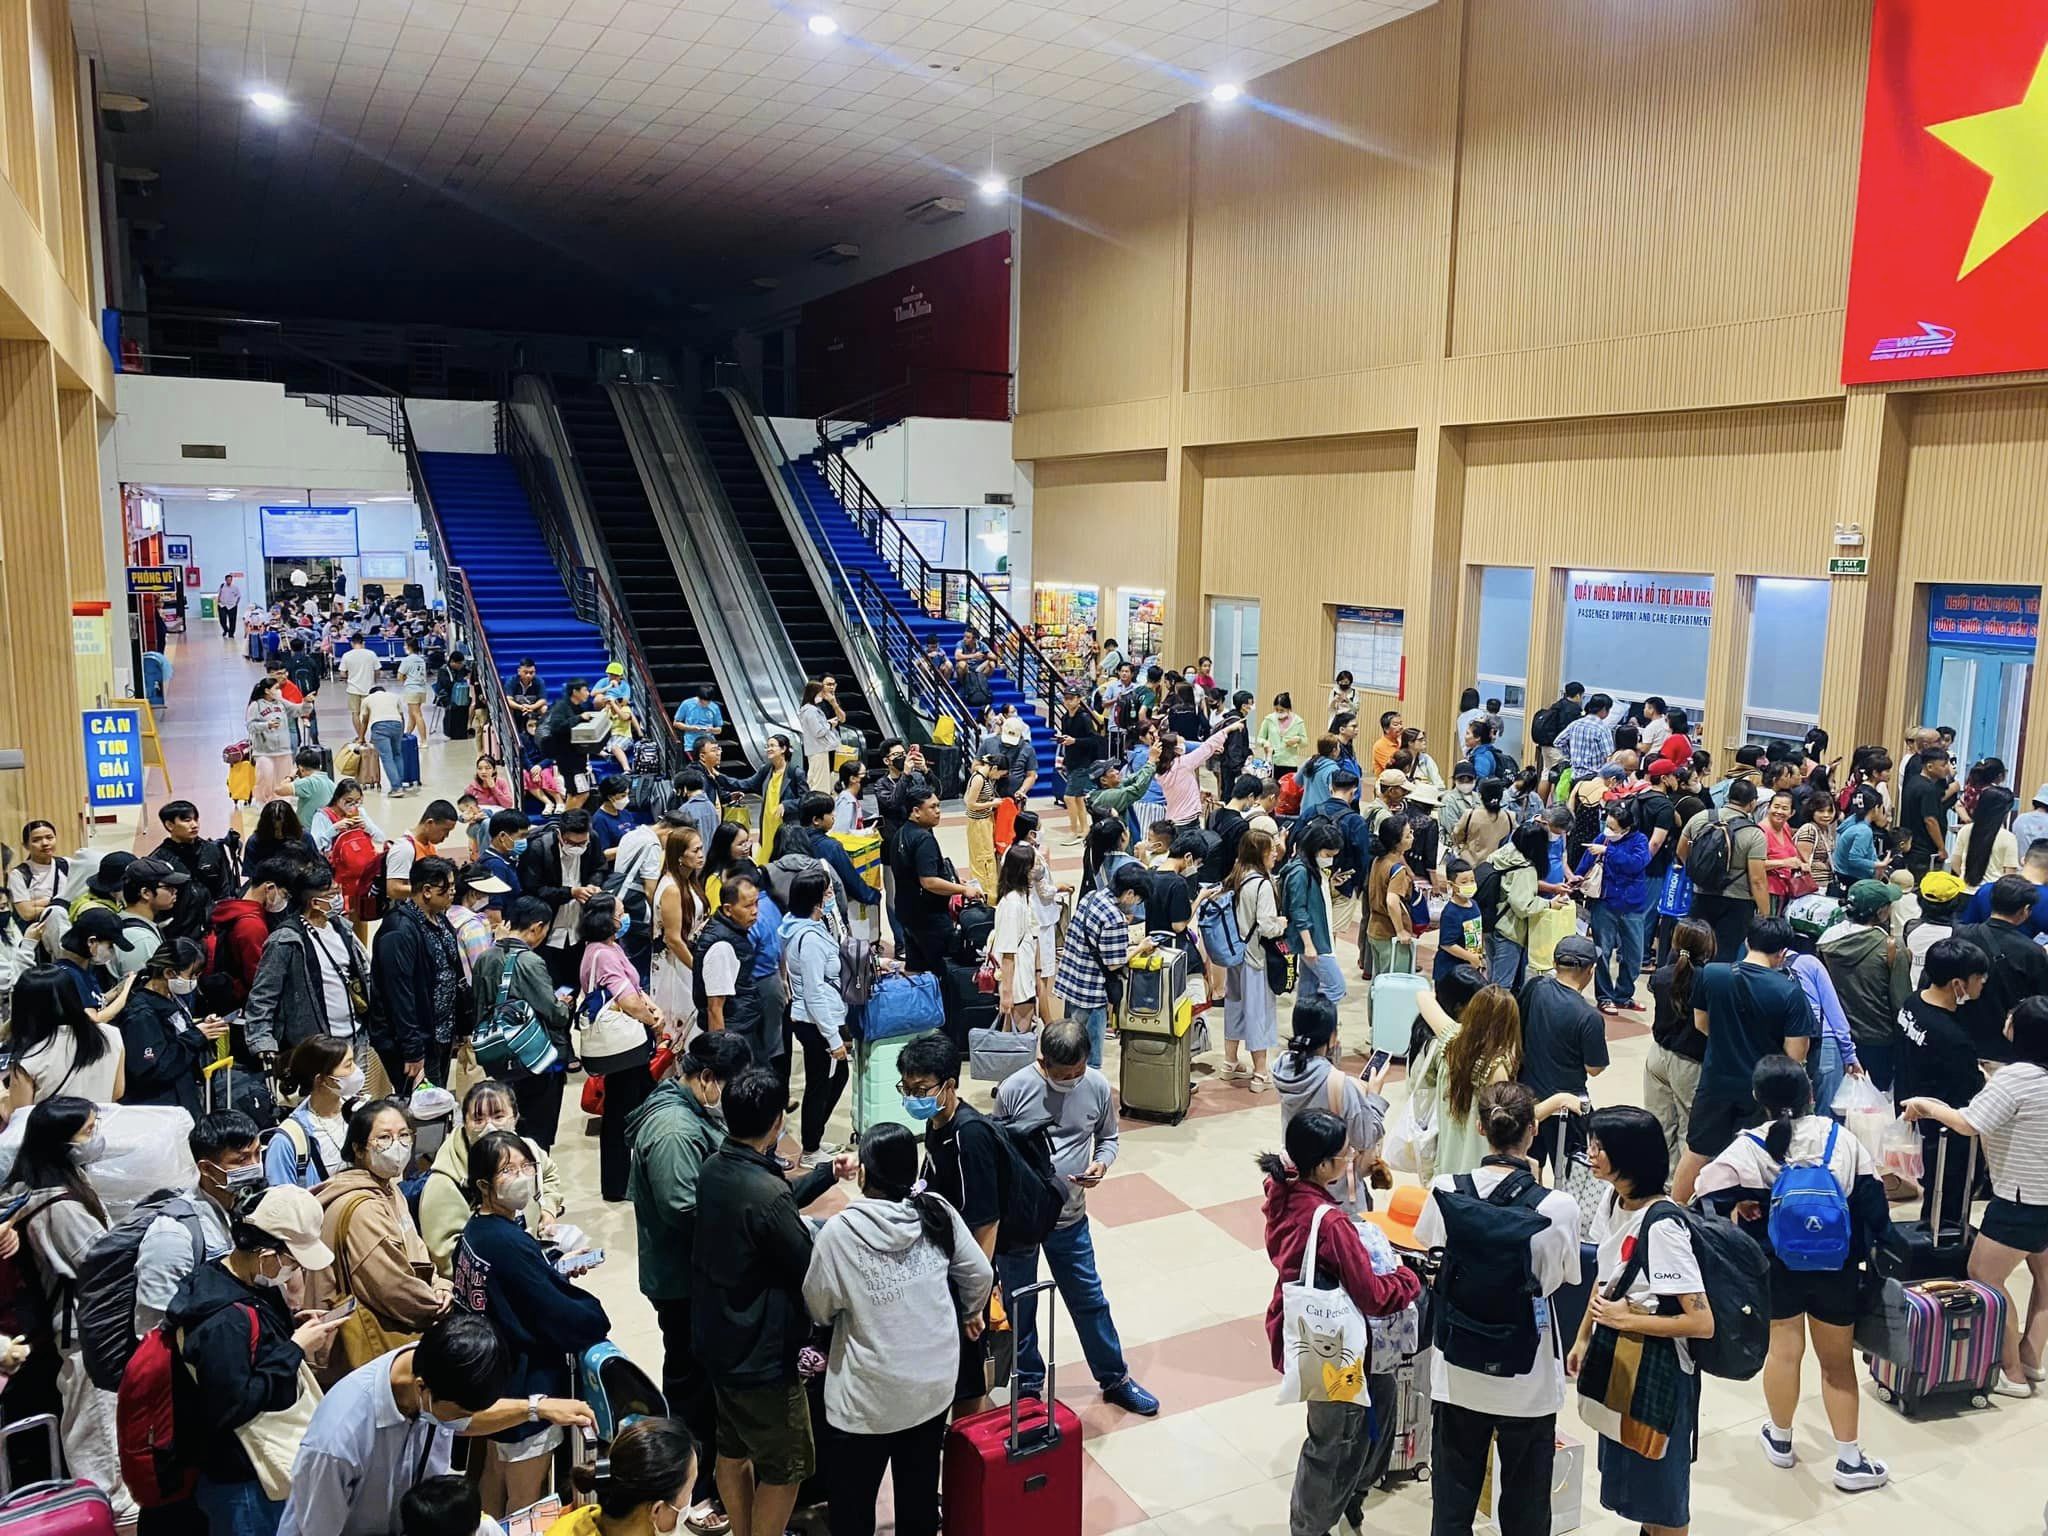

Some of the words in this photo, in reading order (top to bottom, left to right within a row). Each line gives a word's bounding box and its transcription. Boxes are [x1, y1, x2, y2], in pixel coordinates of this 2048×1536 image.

[1578, 608, 1610, 620] PASSENGER
[1612, 610, 1637, 621] SUPPORT
[1638, 612, 1651, 623] AND
[1652, 613, 1668, 624] CARE
[1669, 614, 1712, 627] DEPARTMENT
[97, 739, 129, 755] TIN
[96, 780, 134, 799] KHÁT
[1666, 873, 1679, 910] DECATHLON
[1654, 1272, 1682, 1280] GMO
[1306, 1304, 1323, 1318] Cat
